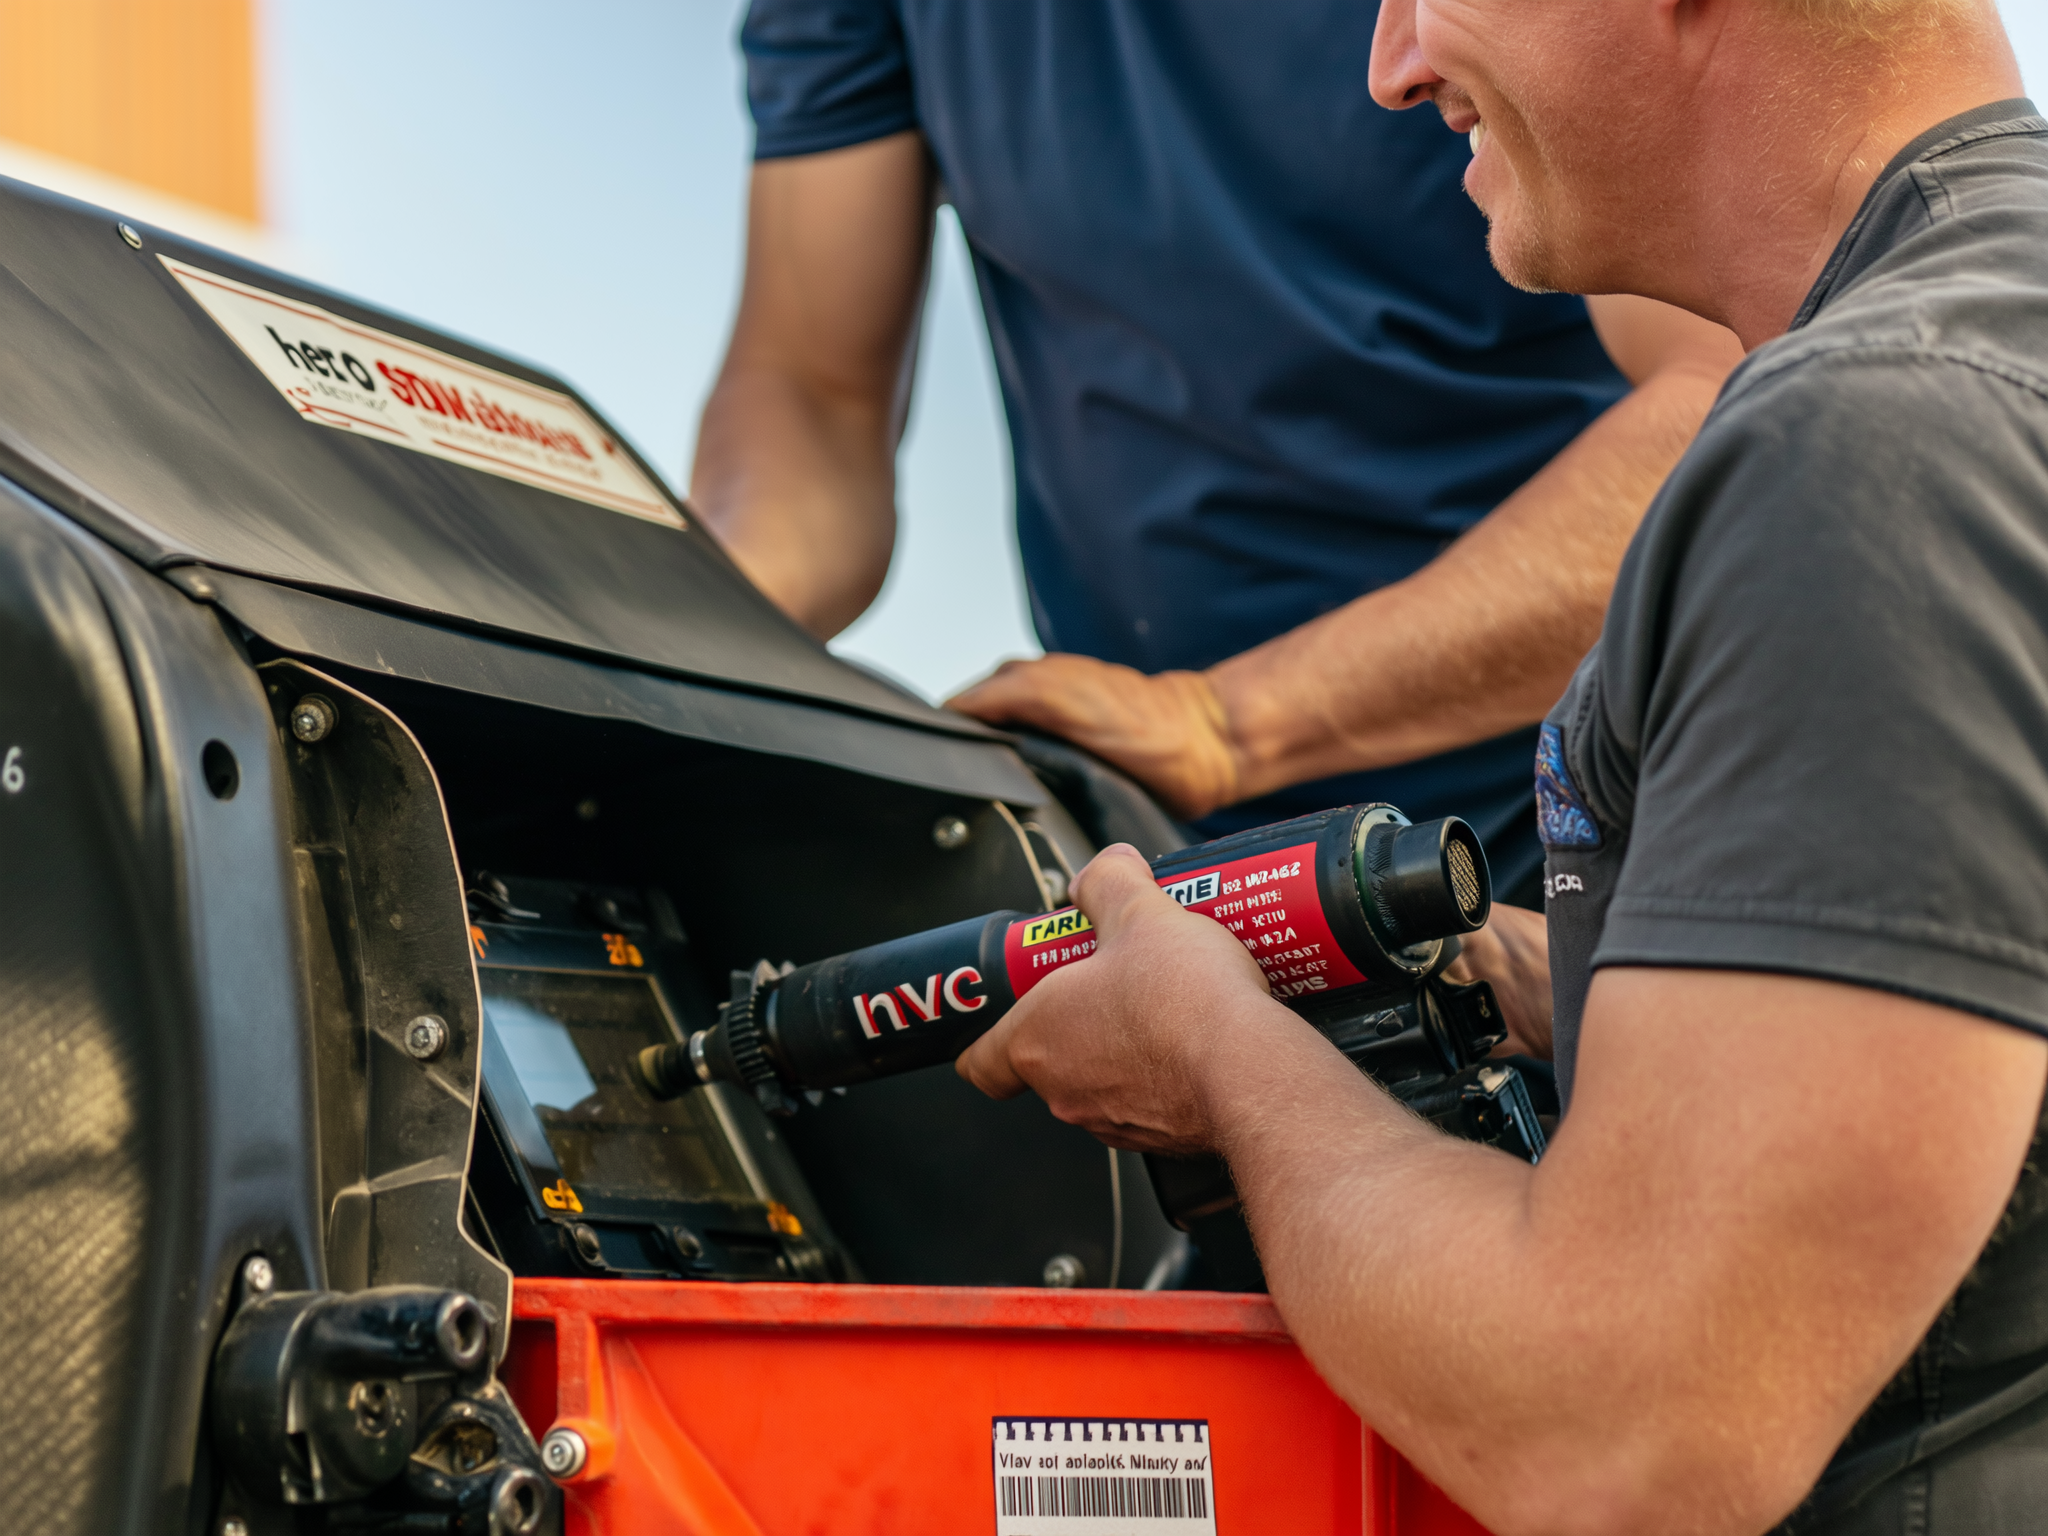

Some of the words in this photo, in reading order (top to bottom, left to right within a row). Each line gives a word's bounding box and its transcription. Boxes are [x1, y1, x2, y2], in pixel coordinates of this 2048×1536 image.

[264, 324, 376, 392] hero
[2, 746, 25, 793] 6
[853, 965, 988, 1039] nvc
